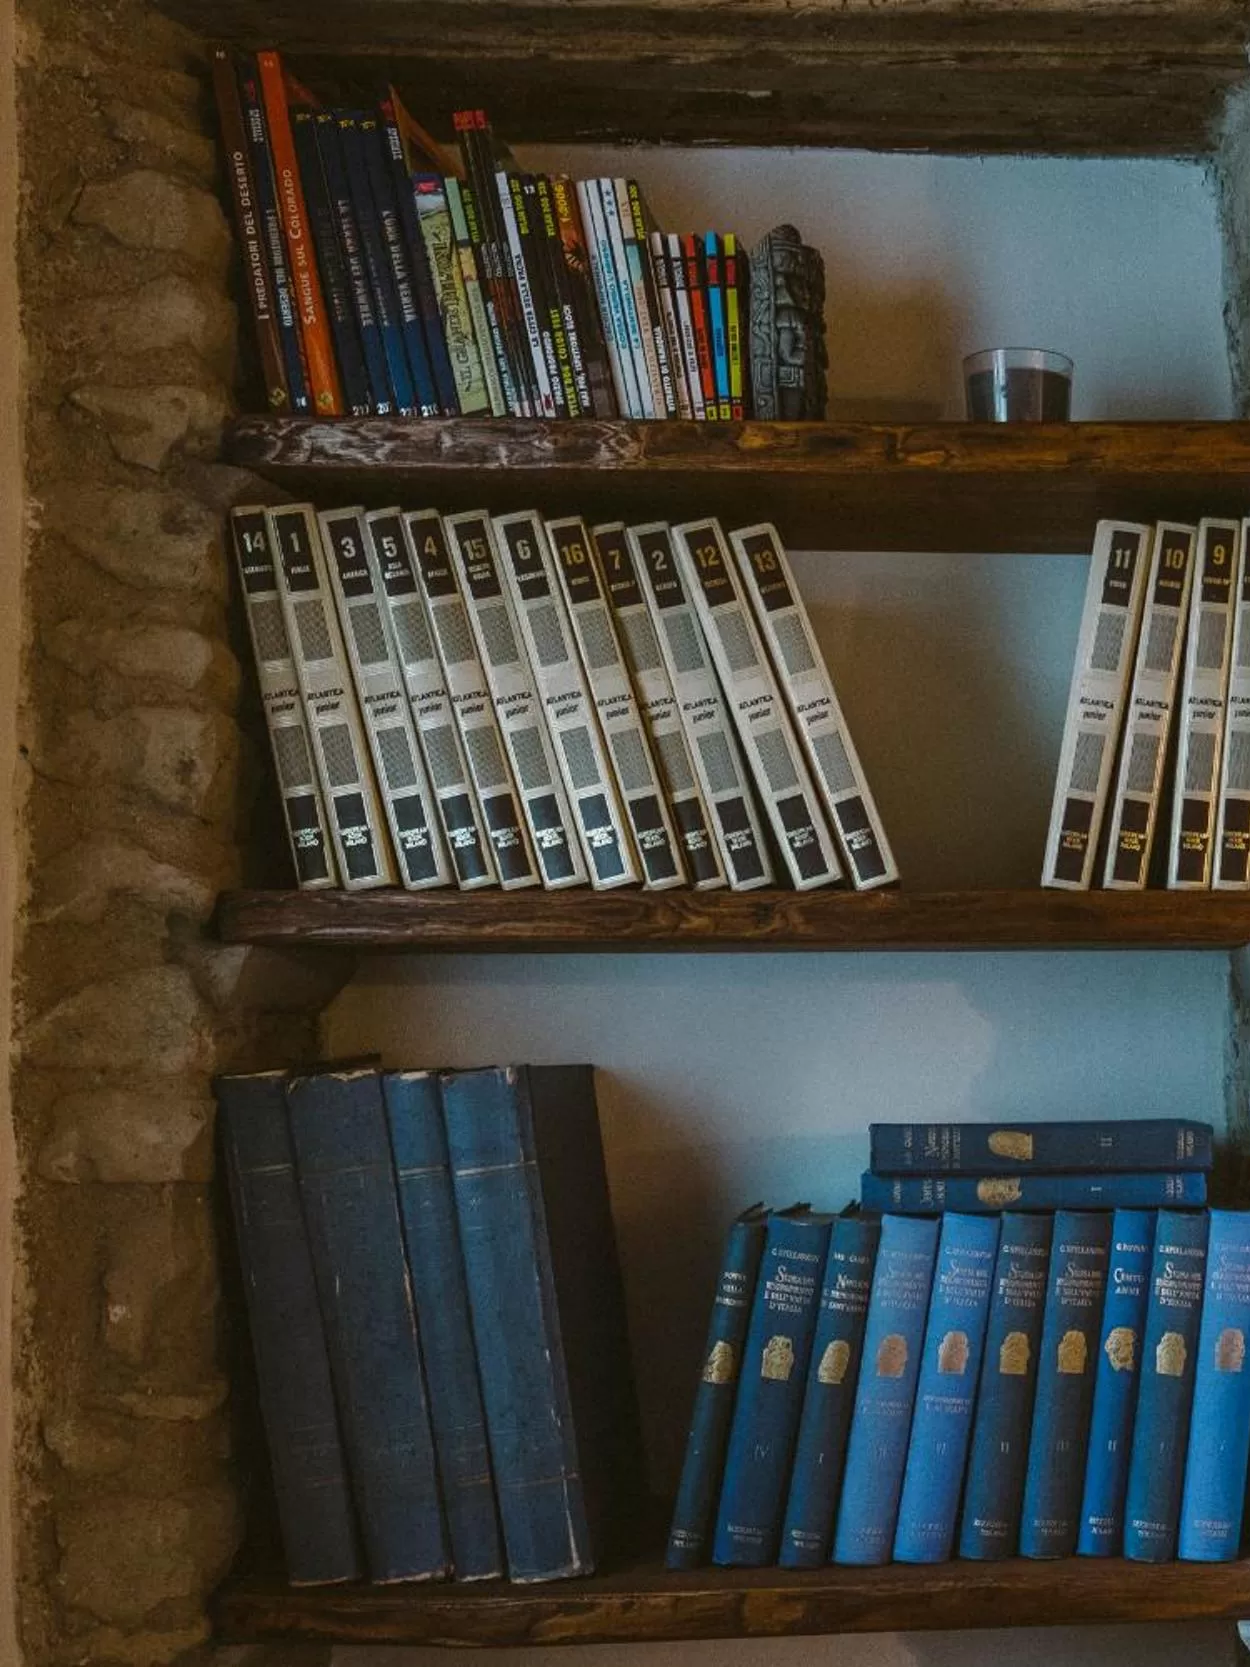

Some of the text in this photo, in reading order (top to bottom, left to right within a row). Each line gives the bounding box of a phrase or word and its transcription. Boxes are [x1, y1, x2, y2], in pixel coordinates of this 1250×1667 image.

[231, 149, 270, 321] I PREDATORI DEL DESERTO
[281, 168, 316, 325] SANGUE SUL COLORADO
[242, 531, 265, 553] 14
[290, 532, 300, 553] 1
[341, 537, 356, 558] 3
[382, 536, 397, 558] 5
[424, 536, 437, 557] 4
[463, 539, 486, 561] 15
[515, 539, 531, 561] 6
[562, 543, 585, 565] 16
[608, 549, 621, 570] 7
[651, 551, 668, 572] 2
[696, 546, 719, 568] 12
[754, 550, 777, 573] 13
[1113, 548, 1131, 570] 11
[1164, 549, 1184, 569] 10
[1212, 544, 1225, 565] 9
